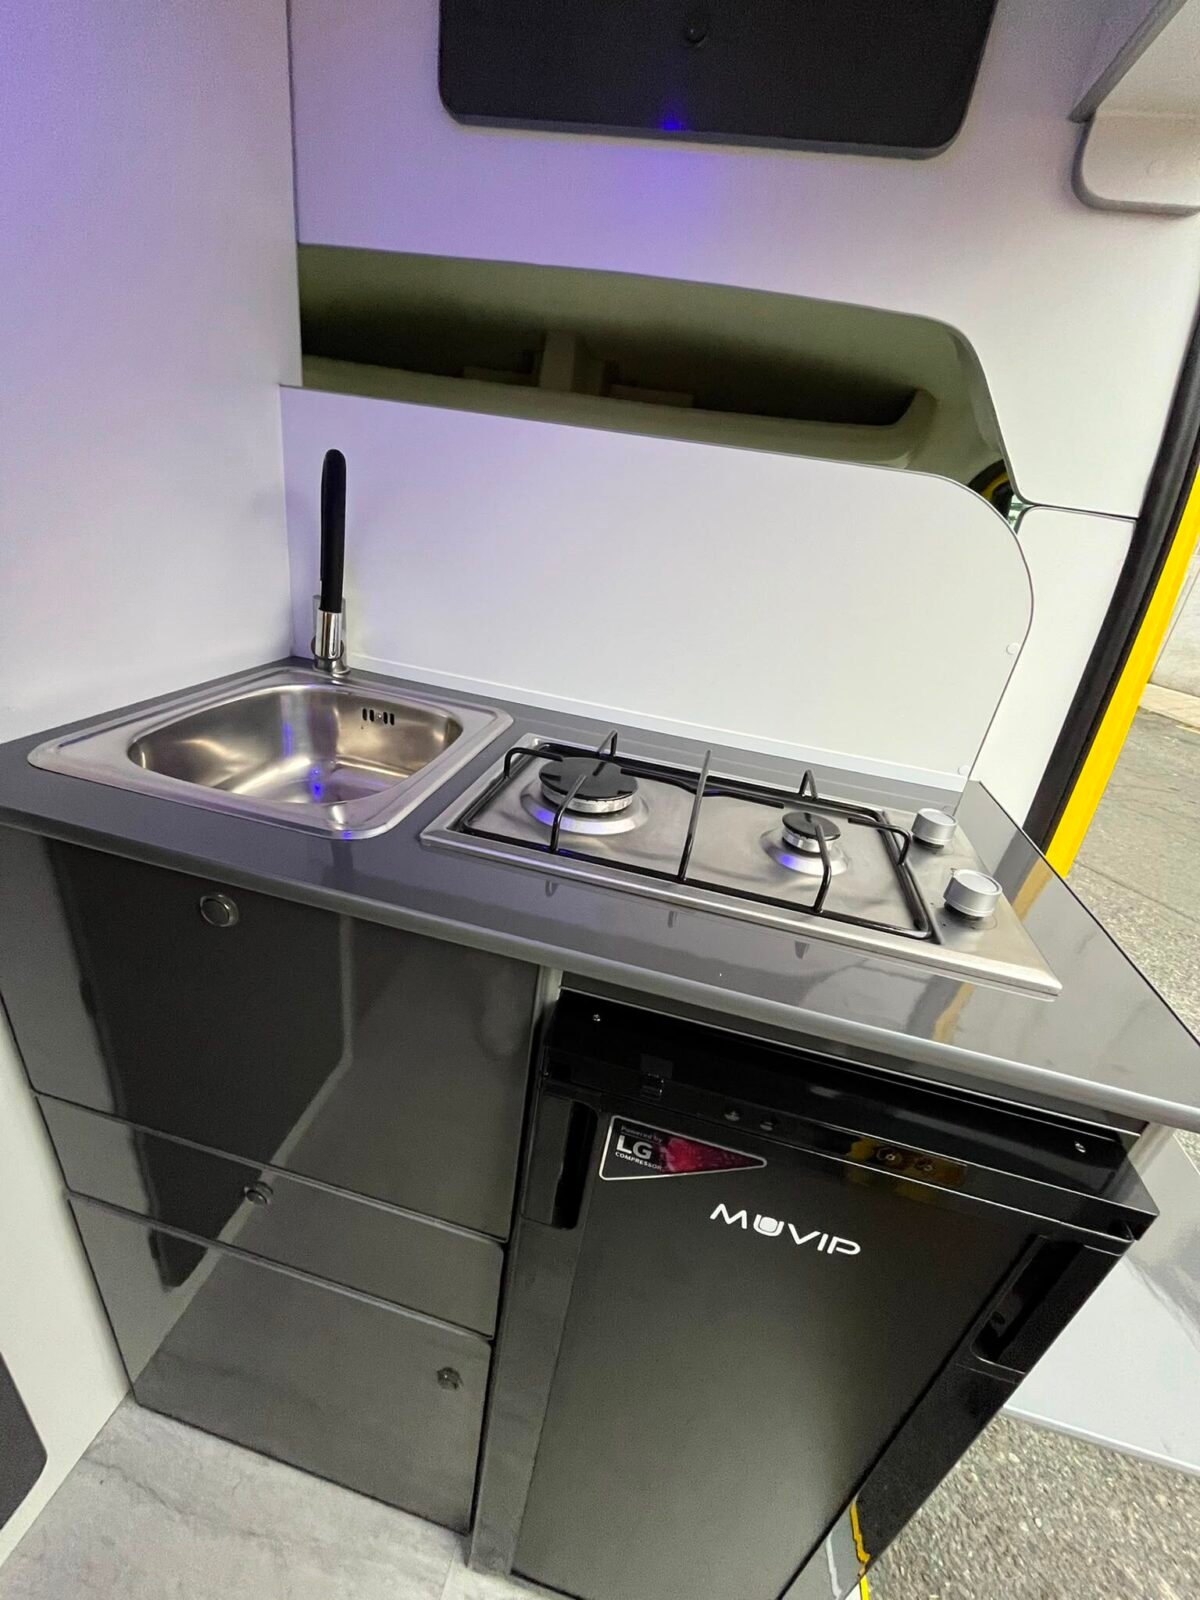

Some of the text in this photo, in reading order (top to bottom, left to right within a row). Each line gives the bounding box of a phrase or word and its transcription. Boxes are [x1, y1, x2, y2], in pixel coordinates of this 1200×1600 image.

[616, 1135, 652, 1159] LG
[615, 1151, 663, 1170] COMPRESSOR
[710, 1203, 861, 1255] MUVIP
